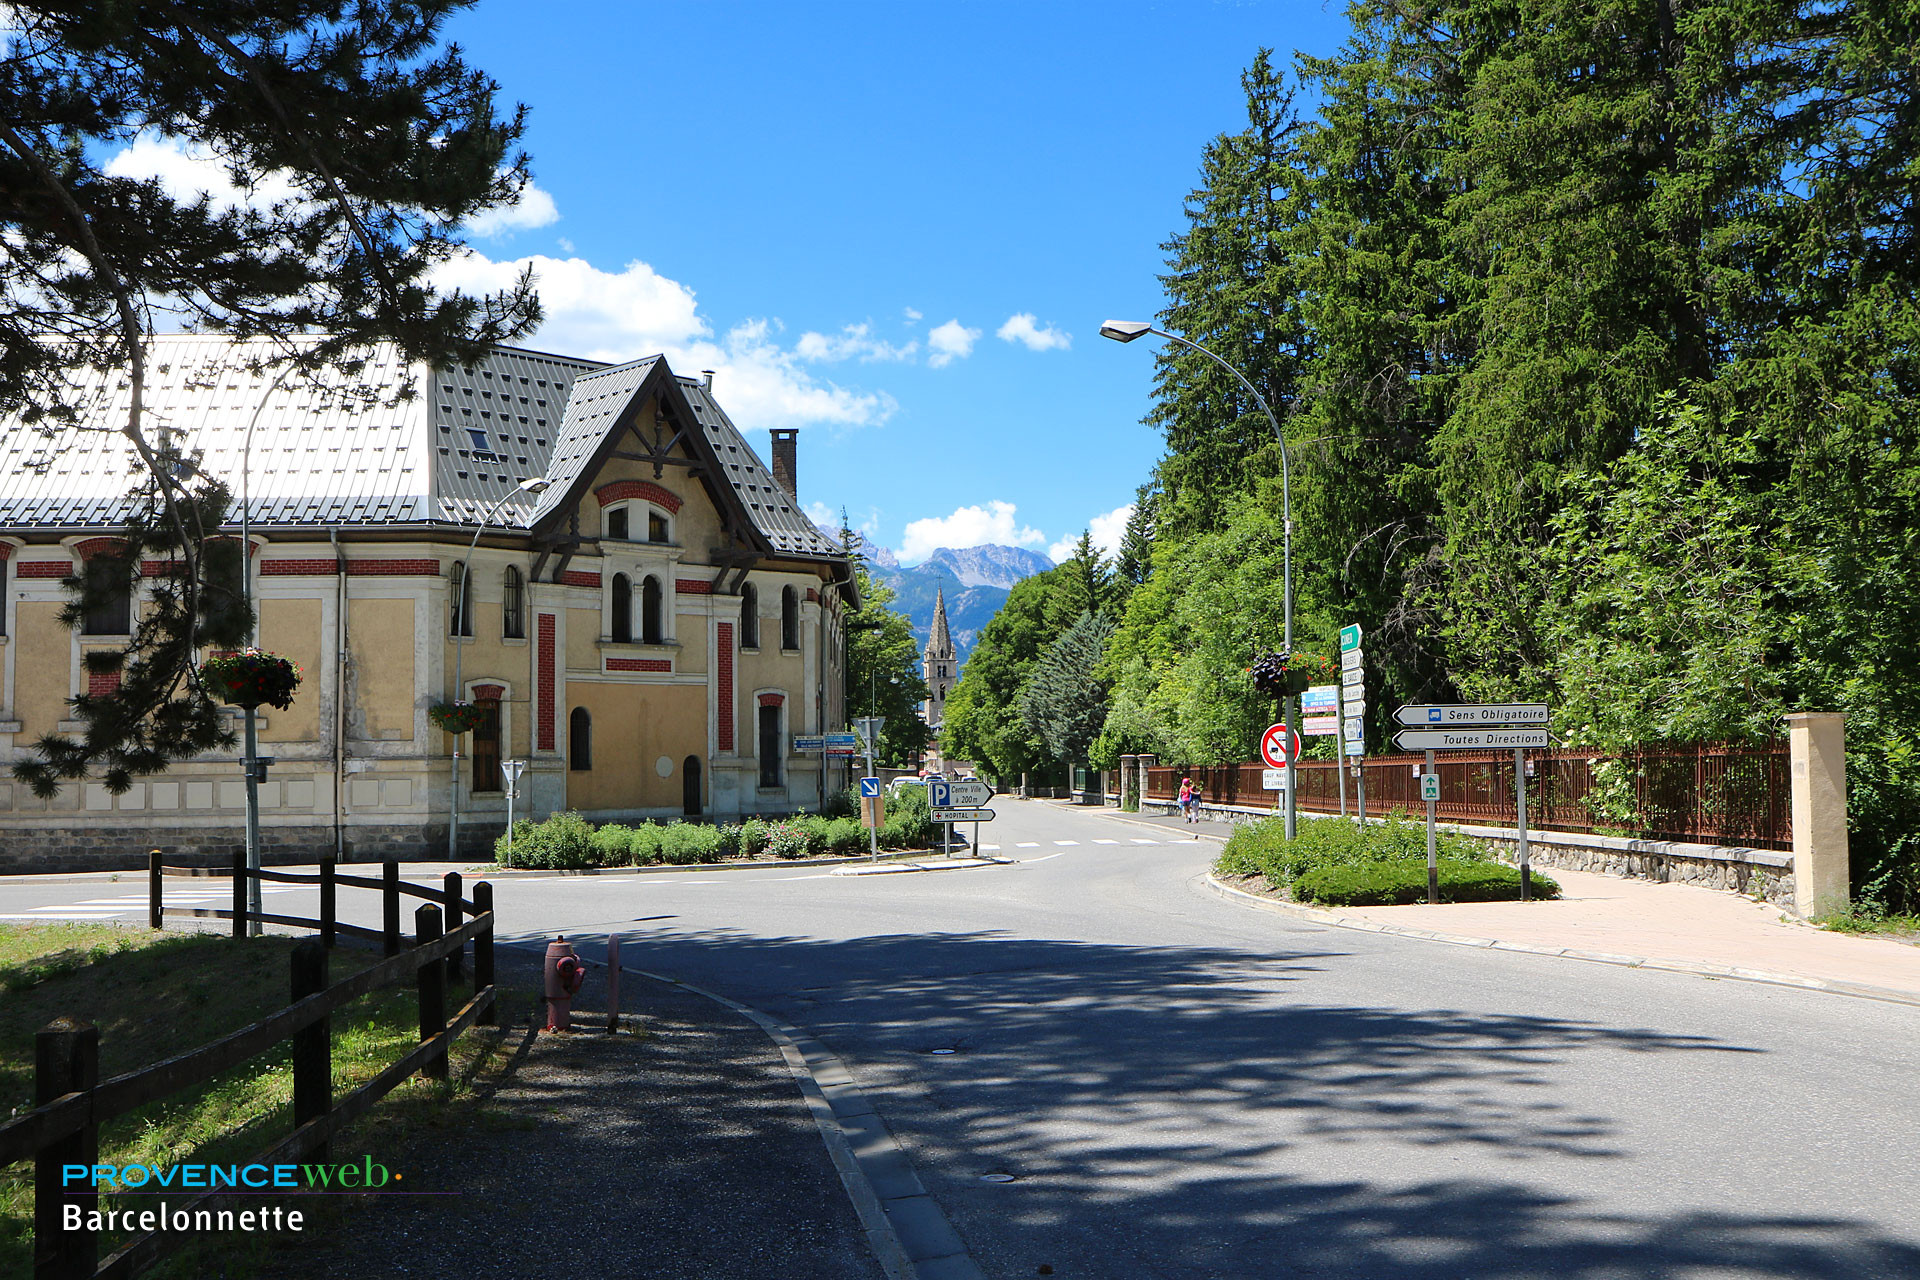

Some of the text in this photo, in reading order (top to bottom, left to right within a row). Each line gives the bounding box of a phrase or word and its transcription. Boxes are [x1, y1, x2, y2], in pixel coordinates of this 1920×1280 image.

[1449, 709, 1544, 721] Sens Obligatoire
[1444, 734, 1544, 745] Toutes Directions
[936, 785, 947, 805] P
